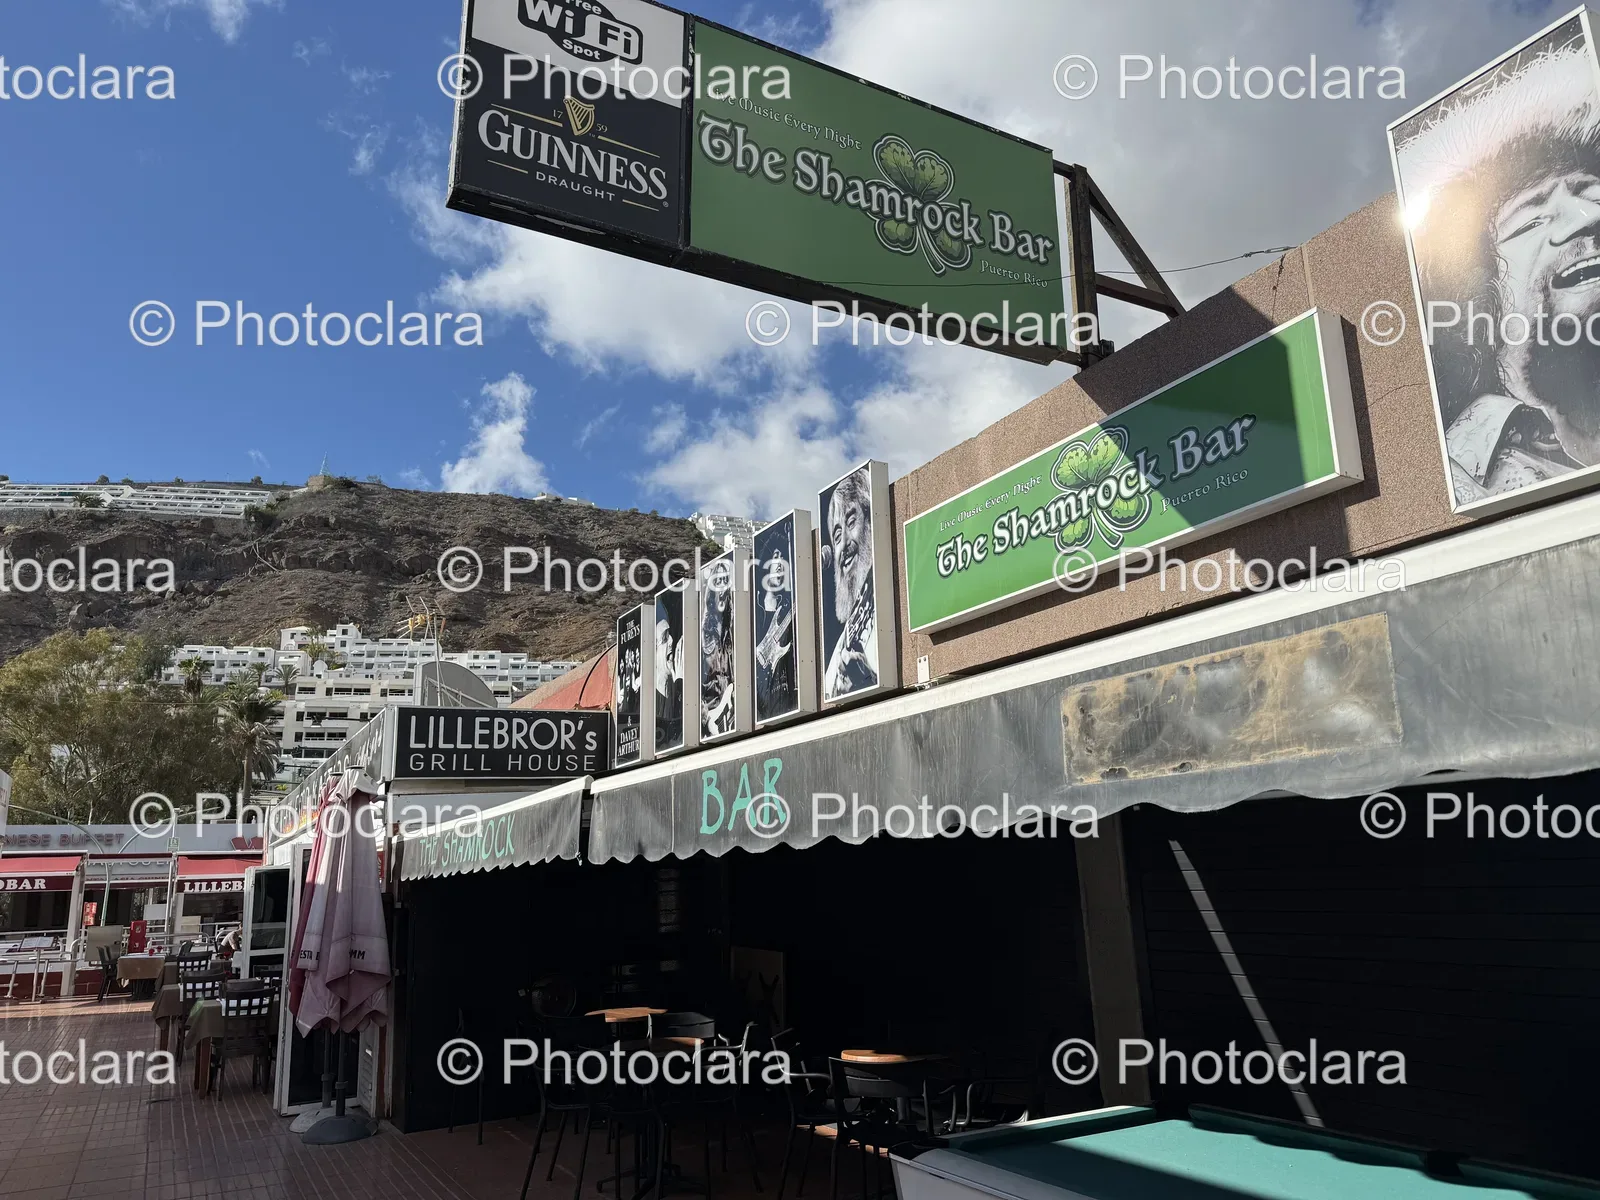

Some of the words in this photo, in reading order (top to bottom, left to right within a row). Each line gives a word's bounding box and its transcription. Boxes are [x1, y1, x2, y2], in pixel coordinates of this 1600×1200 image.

[562, 38, 601, 60] Spot
[596, 123, 608, 133] 59
[739, 97, 781, 122] Music
[784, 114, 821, 139] Every
[824, 126, 862, 150] Night
[477, 109, 668, 200] GUINNESS
[536, 171, 616, 201] DRAUGHT
[698, 111, 786, 181] The
[793, 147, 985, 247] Shamrock
[988, 210, 1054, 264] Bar
[981, 260, 1020, 280] Puerto
[1024, 272, 1048, 288] Rico
[936, 532, 988, 578] The
[992, 448, 1166, 554] Shamrock
[1167, 414, 1256, 482] Bar
[939, 517, 956, 532] Live
[957, 504, 983, 523] Music
[985, 490, 1011, 510] Every
[1013, 475, 1042, 496] Night
[1160, 484, 1211, 515] Puerto
[1215, 469, 1249, 491] Rico
[409, 715, 598, 751] LILLEBROR's
[617, 739, 640, 757] ARTHUR
[409, 753, 491, 771] GRILL
[508, 754, 596, 772] HOUSE
[700, 757, 787, 835] BAR
[420, 836, 439, 866] THE
[183, 880, 244, 893] LILLEB
